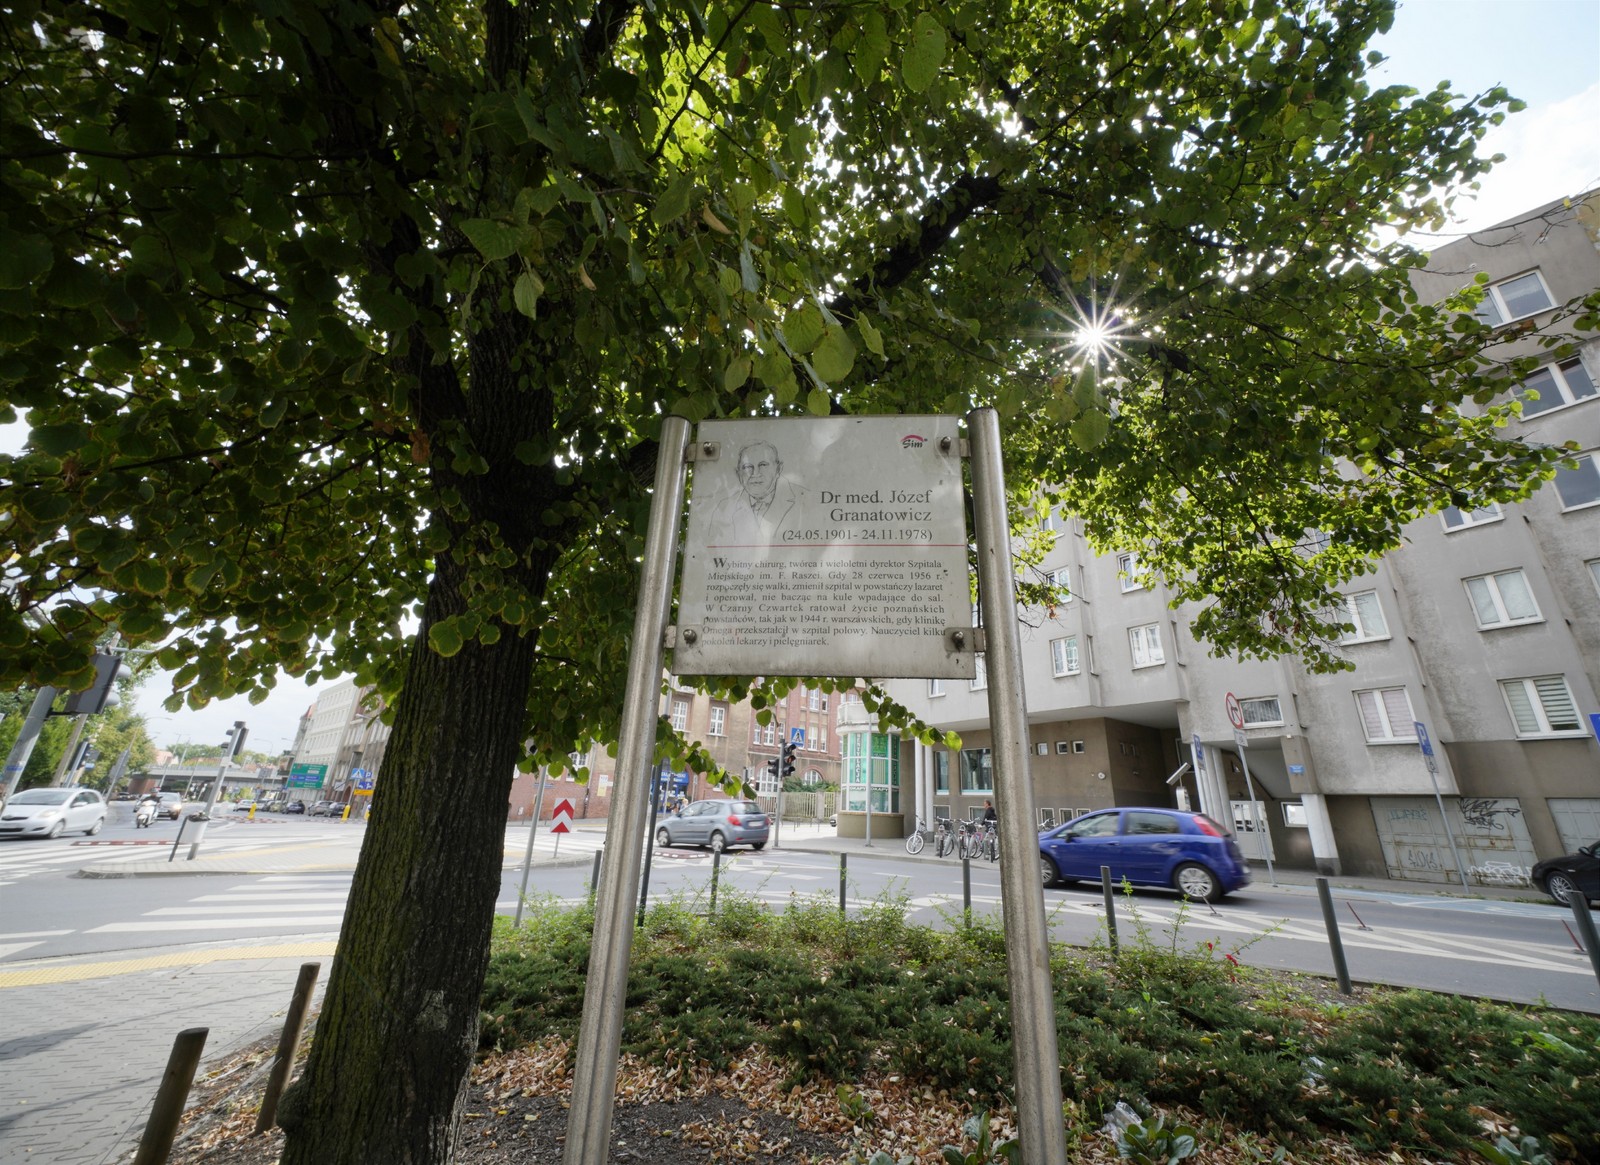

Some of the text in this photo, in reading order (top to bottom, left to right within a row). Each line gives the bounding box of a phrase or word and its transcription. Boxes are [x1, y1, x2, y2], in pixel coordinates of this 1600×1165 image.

[902, 439, 924, 449] Sim
[820, 489, 933, 504] Dr med. Józef
[830, 508, 932, 522] Granatowicz
[862, 529, 933, 541] 24.11.1978)
[713, 557, 753, 570] Wybitny
[755, 559, 787, 570] chirurg,
[789, 559, 818, 568] twórca
[826, 559, 867, 568] wieloletni
[870, 559, 905, 570] dyrektor
[907, 559, 942, 570] Szpitala
[708, 572, 754, 582] Miejskiego
[760, 572, 773, 580] im.
[778, 571, 786, 580] F.
[828, 571, 847, 581] Gdy
[852, 571, 863, 580] 28
[910, 571, 931, 580] 1956
[936, 573, 942, 581] r.
[752, 583, 764, 592] się
[765, 582, 791, 591] walki,
[792, 582, 824, 591] zmienił
[825, 582, 852, 592] szpital
[914, 582, 943, 591] lazaret
[705, 593, 709, 602] i
[713, 593, 756, 603] operował,
[781, 593, 811, 602] bacząc
[833, 593, 852, 601] kule
[911, 594, 923, 602] do
[928, 593, 944, 602] sal.
[705, 604, 714, 612] W
[719, 604, 753, 614] Czarny
[758, 603, 804, 612] Czwartek
[759, 615, 773, 623] tak
[773, 615, 787, 625] jak
[800, 615, 821, 623] 1944
[896, 615, 913, 625] gdy
[802, 626, 830, 636] szpital
[871, 626, 920, 636] Nauczyciel
[923, 627, 946, 636] kilku
[736, 637, 768, 647] lekarzy
